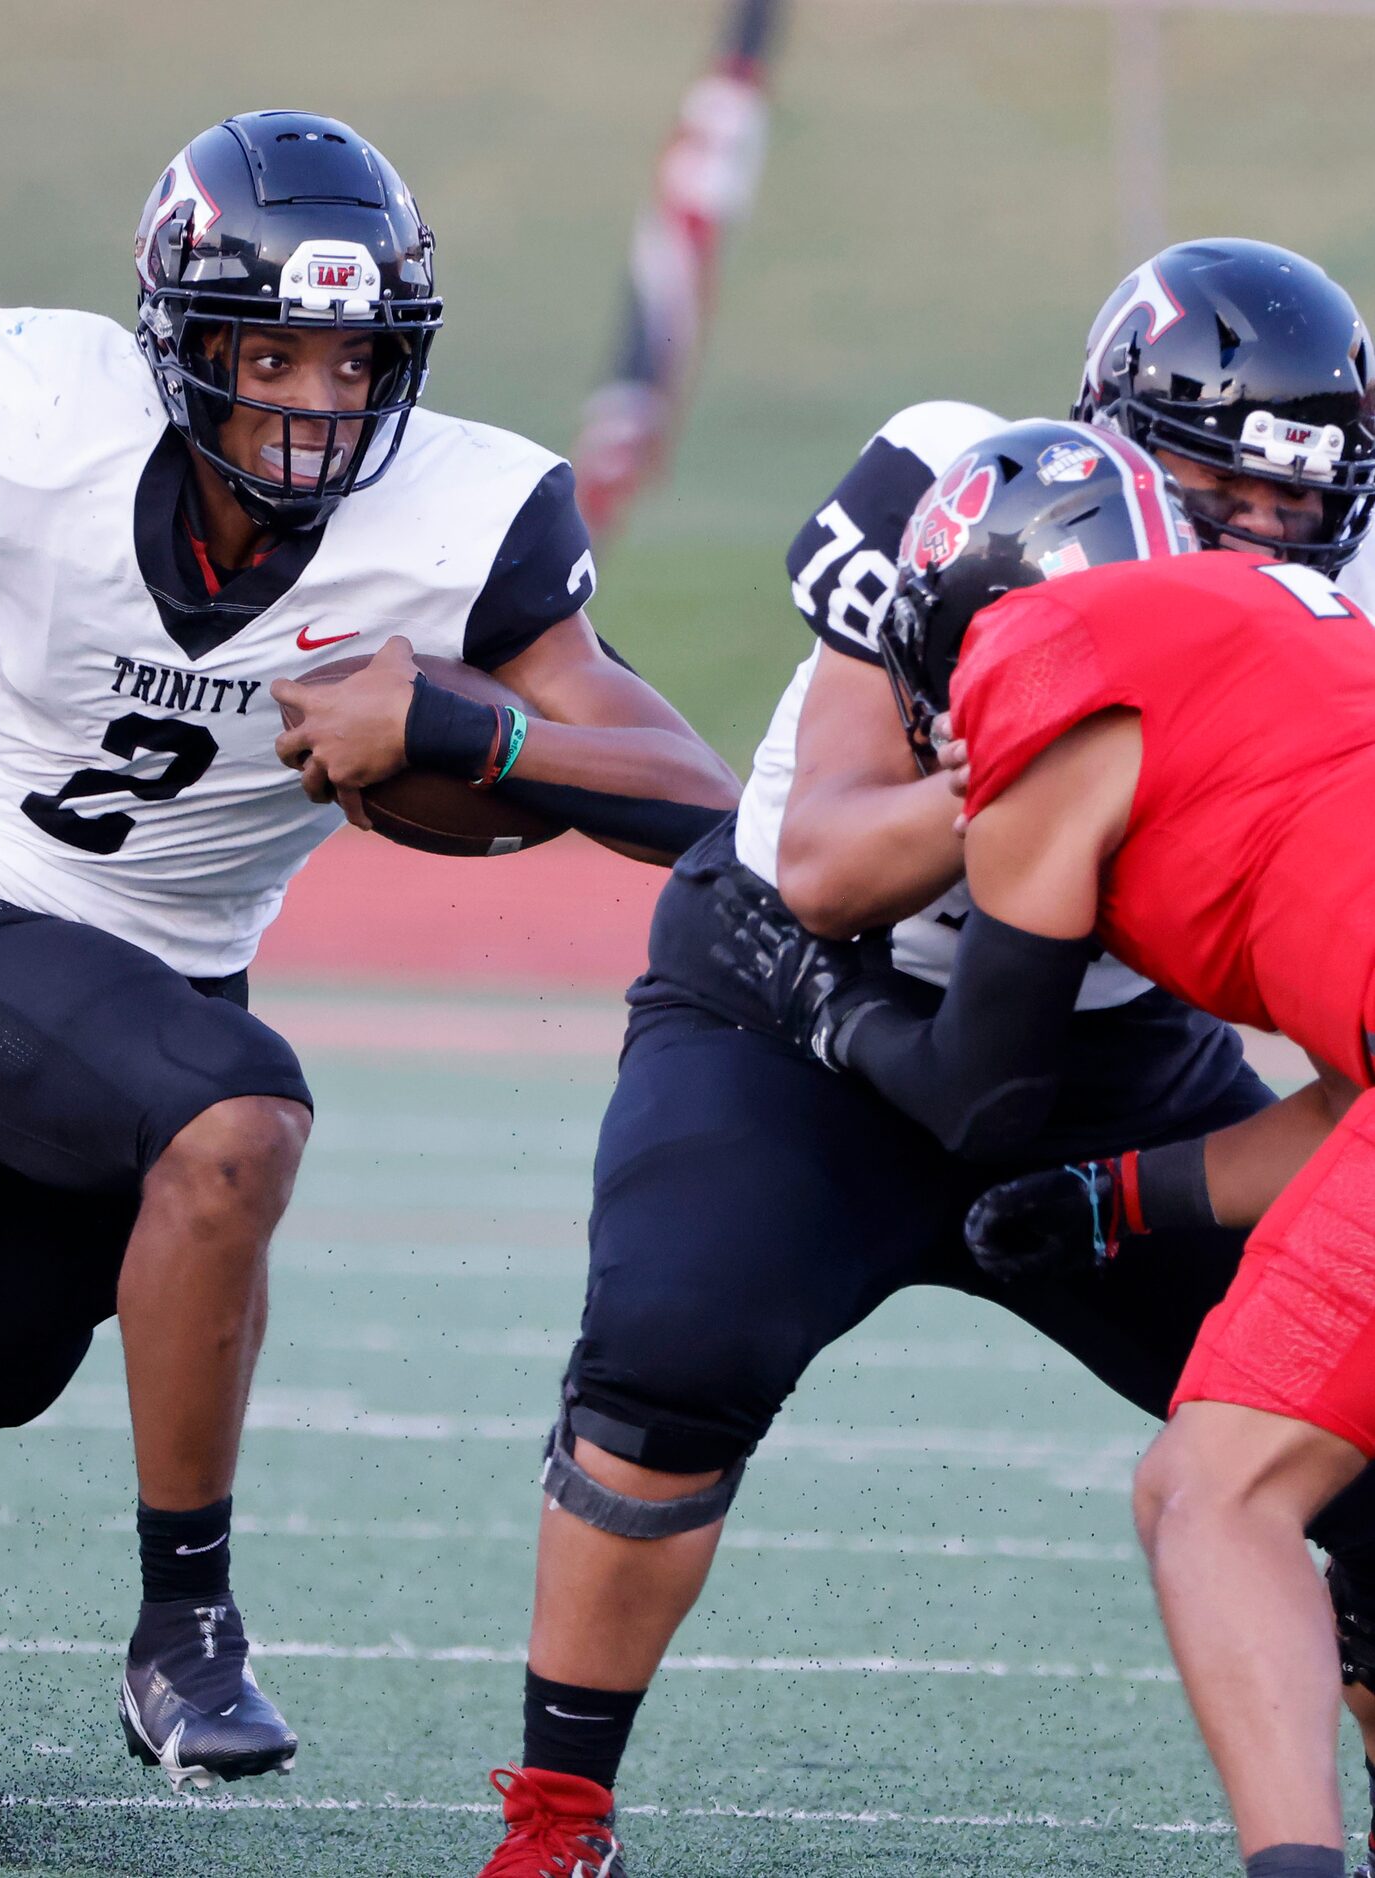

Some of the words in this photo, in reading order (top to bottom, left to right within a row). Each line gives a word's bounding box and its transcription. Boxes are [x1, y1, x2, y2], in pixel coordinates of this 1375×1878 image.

[792, 499, 899, 653] 78
[111, 655, 262, 716] TRINITY
[20, 711, 219, 856] 2
